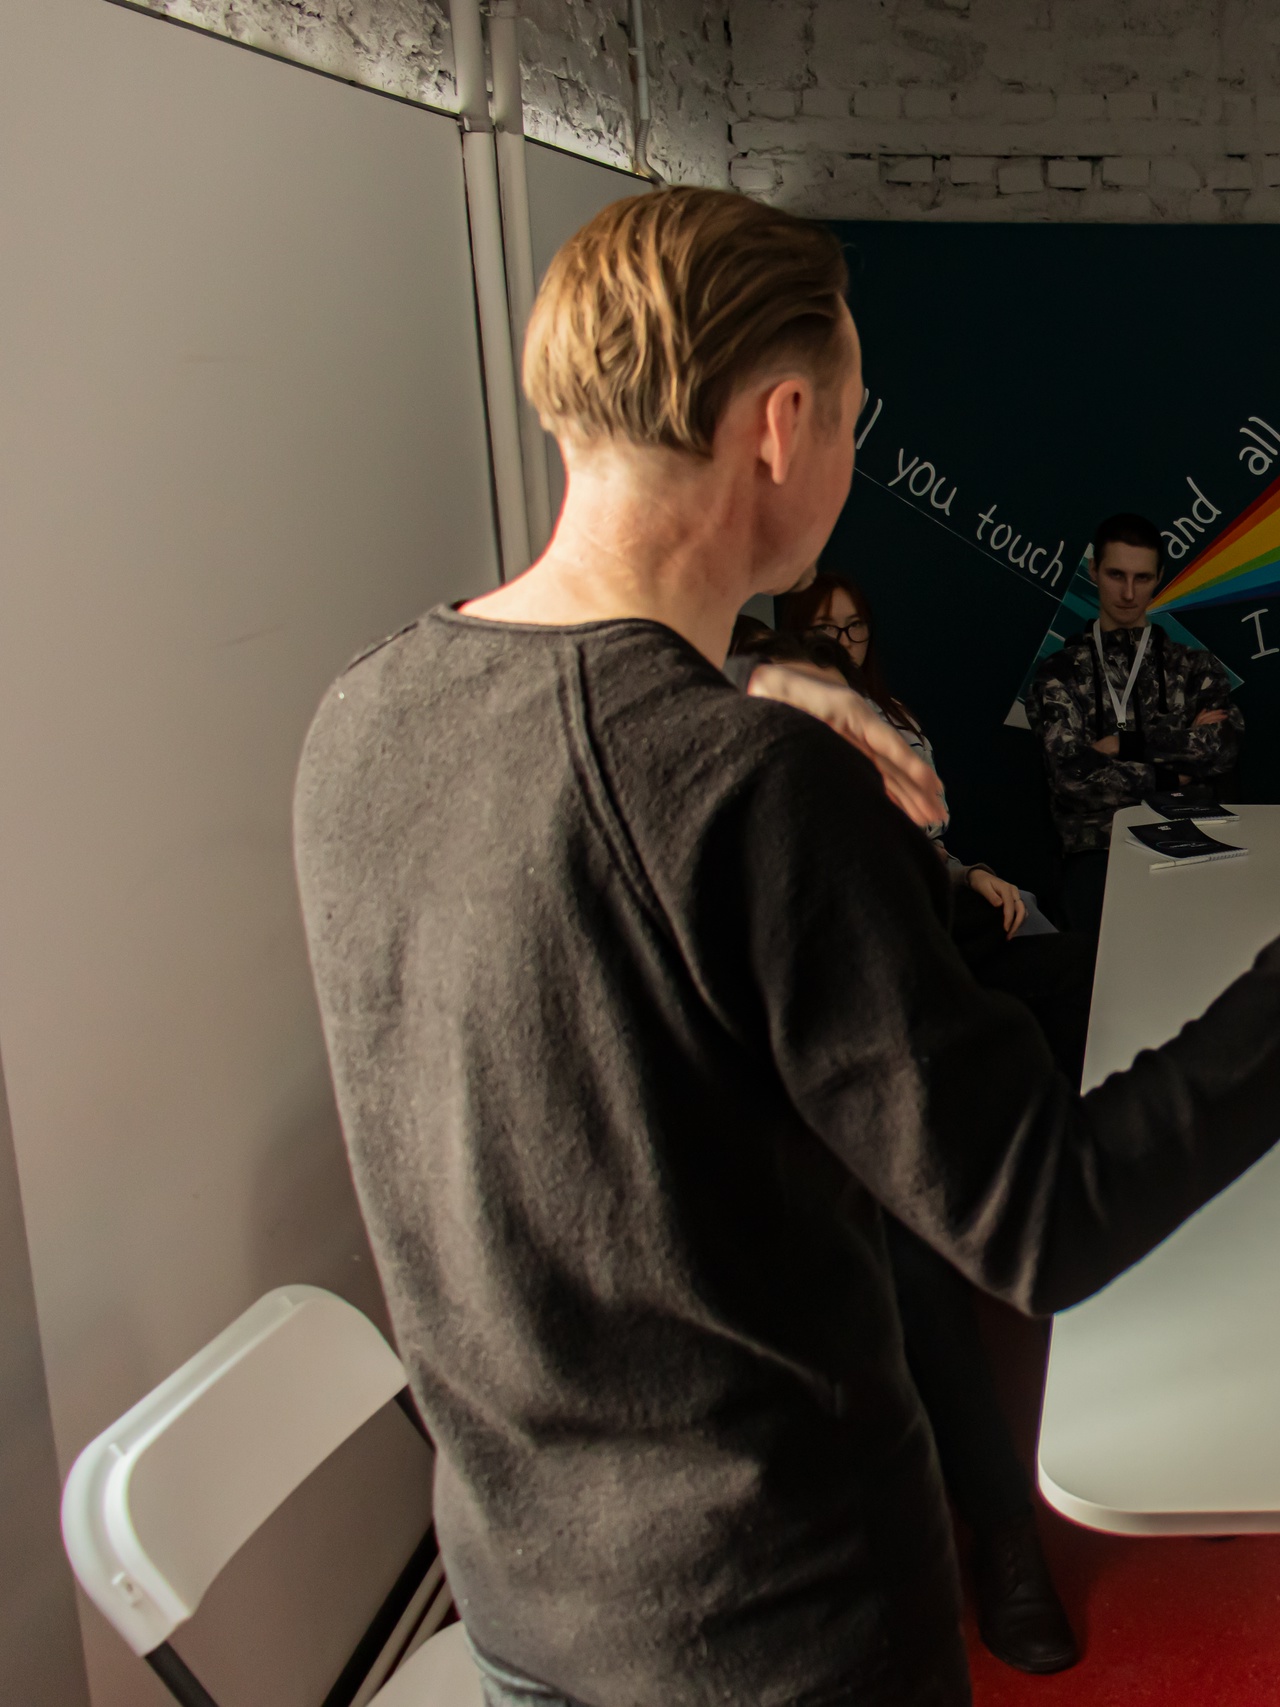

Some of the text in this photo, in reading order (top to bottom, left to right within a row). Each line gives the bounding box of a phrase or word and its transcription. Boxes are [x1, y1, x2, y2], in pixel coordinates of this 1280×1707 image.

[888, 448, 958, 516] you
[977, 504, 1065, 588] touch
[1161, 476, 1222, 560] and
